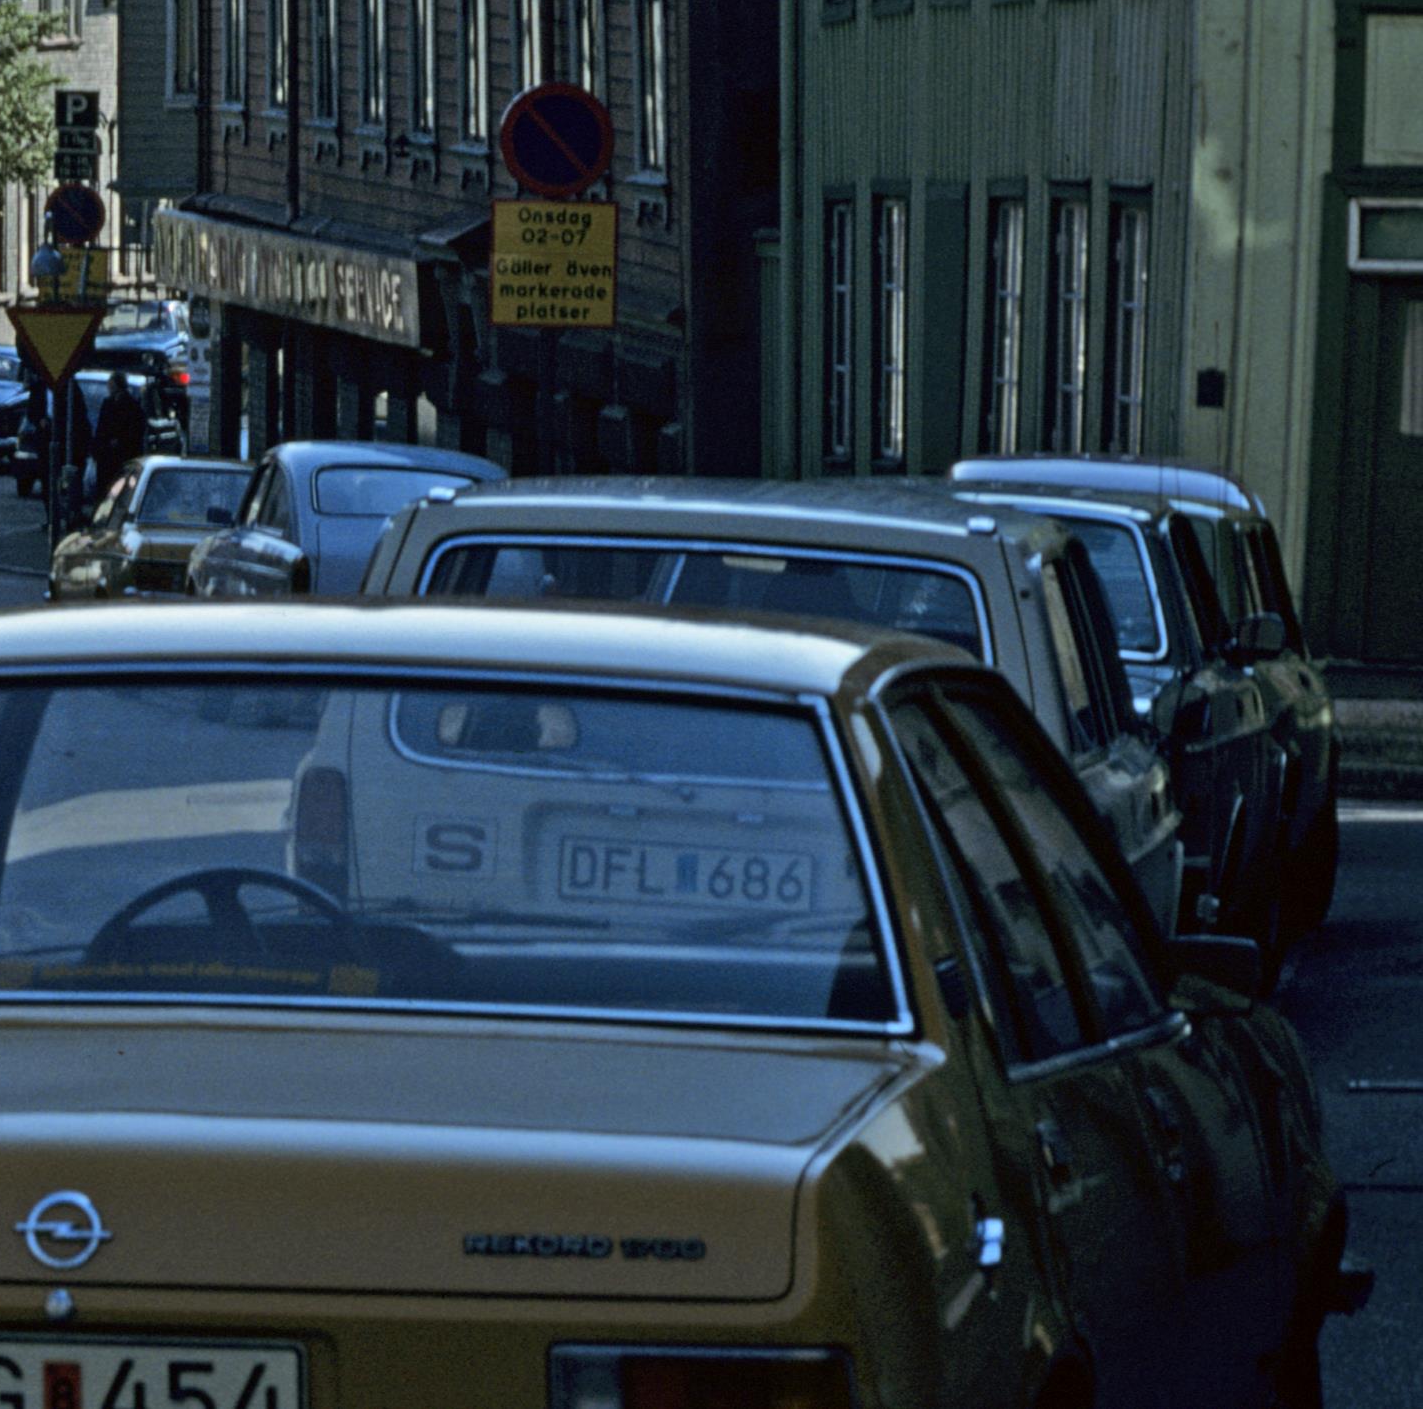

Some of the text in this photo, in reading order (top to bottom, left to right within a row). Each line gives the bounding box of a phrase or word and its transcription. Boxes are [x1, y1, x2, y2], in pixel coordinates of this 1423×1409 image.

[65, 94, 88, 125] P
[518, 206, 592, 229] Onsdag
[522, 228, 587, 247] 02-07
[497, 258, 612, 277] Gäller även
[335, 260, 403, 332] SERVICE
[499, 281, 607, 300] markerade
[516, 302, 590, 321] platser
[425, 822, 487, 872] S
[569, 844, 804, 903] DFL 686
[463, 1233, 613, 1259] REKORD
